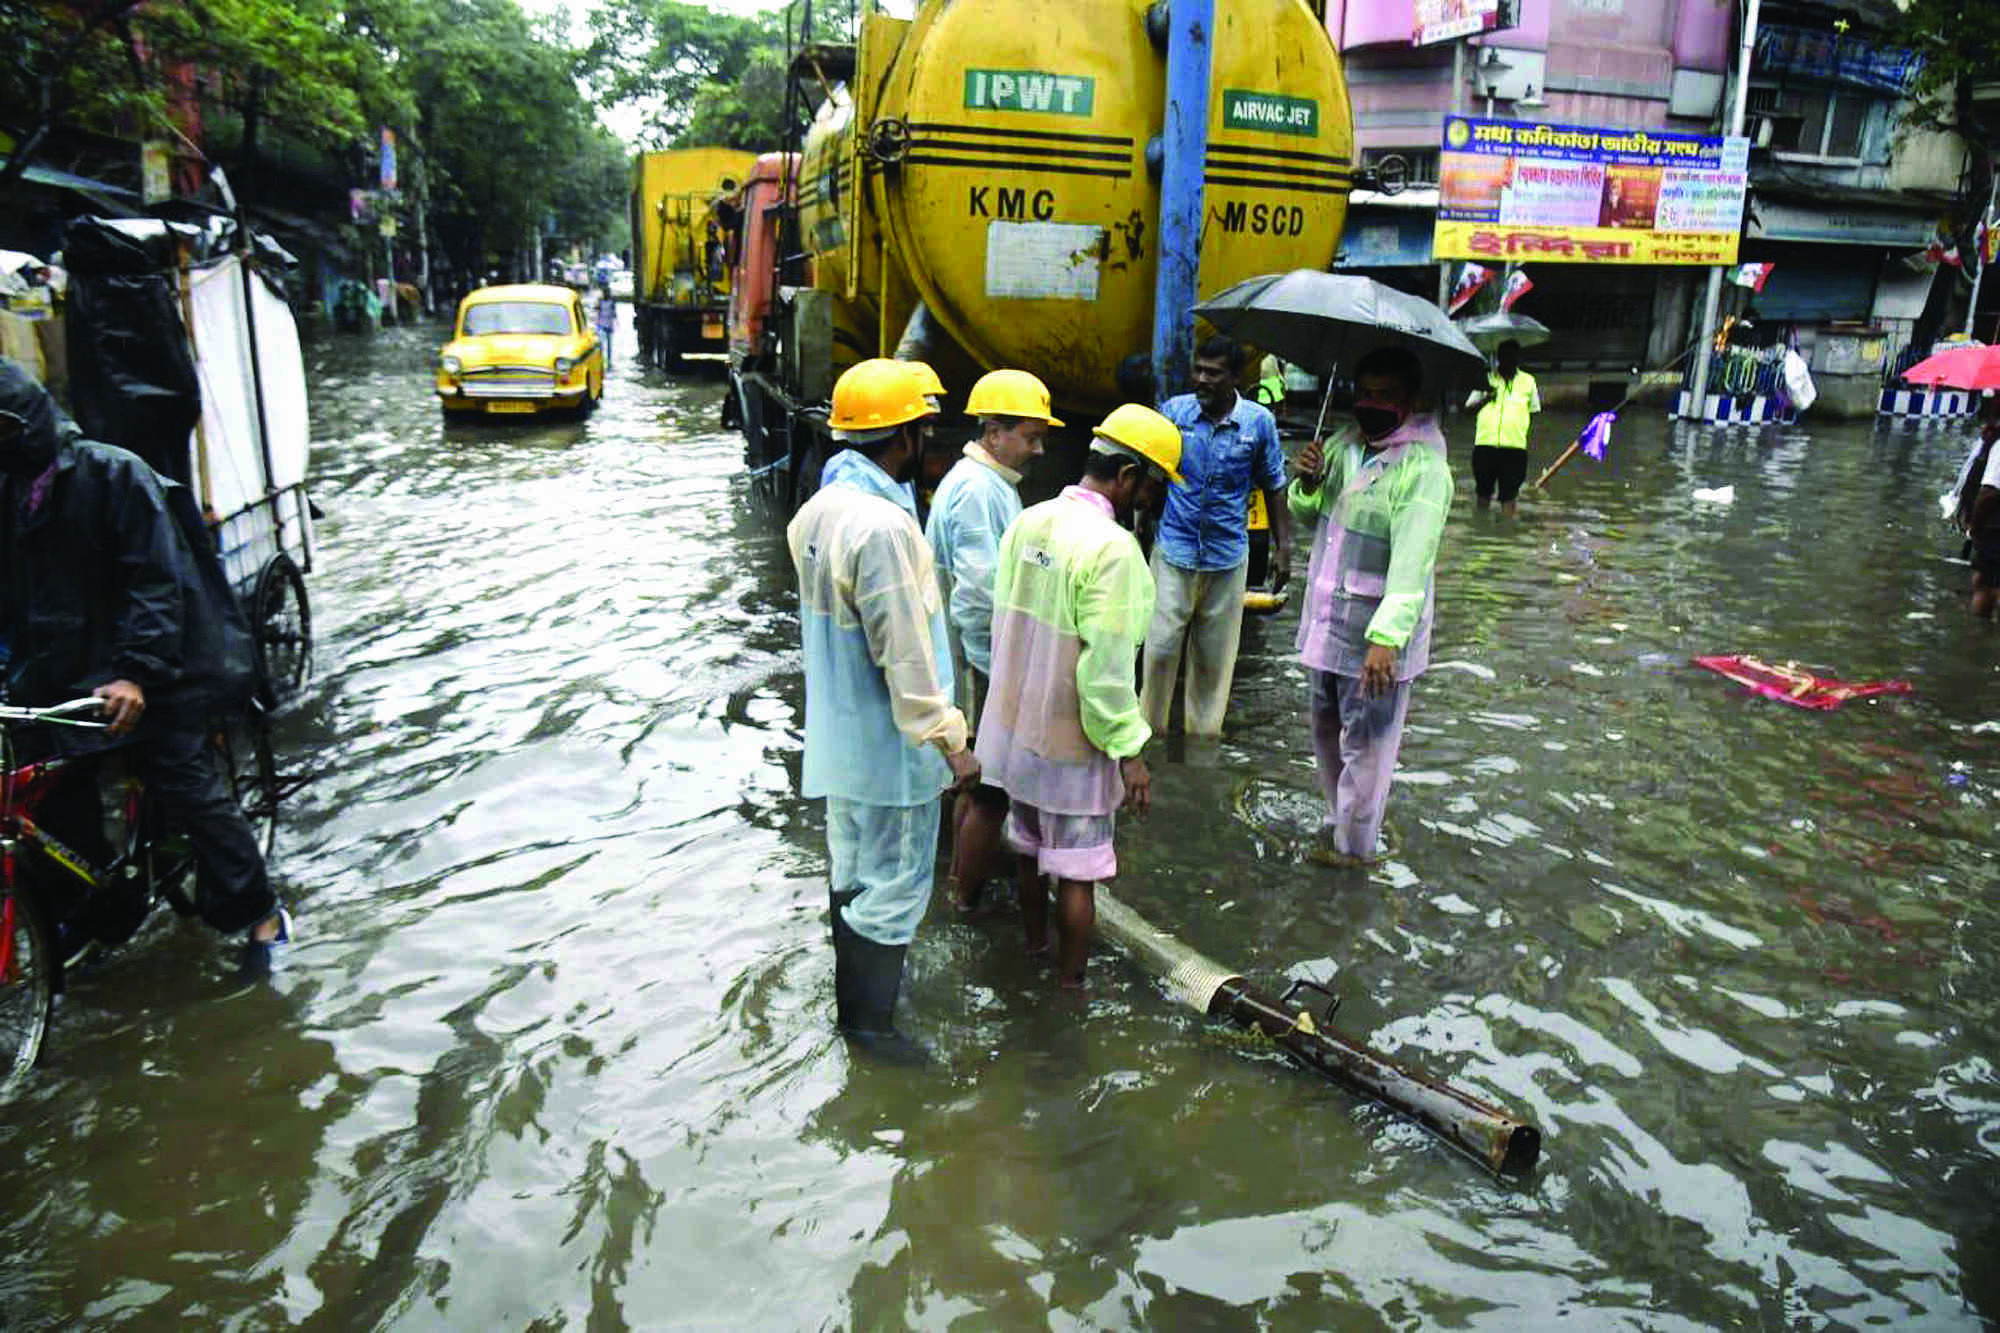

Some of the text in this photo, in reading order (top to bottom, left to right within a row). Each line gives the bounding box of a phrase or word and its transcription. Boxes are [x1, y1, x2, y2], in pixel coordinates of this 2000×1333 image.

[975, 71, 1083, 113] IPWT
[1232, 101, 1311, 126] AIRVAC JET
[969, 186, 1055, 221] KMC
[1223, 201, 1304, 237] MSCD
